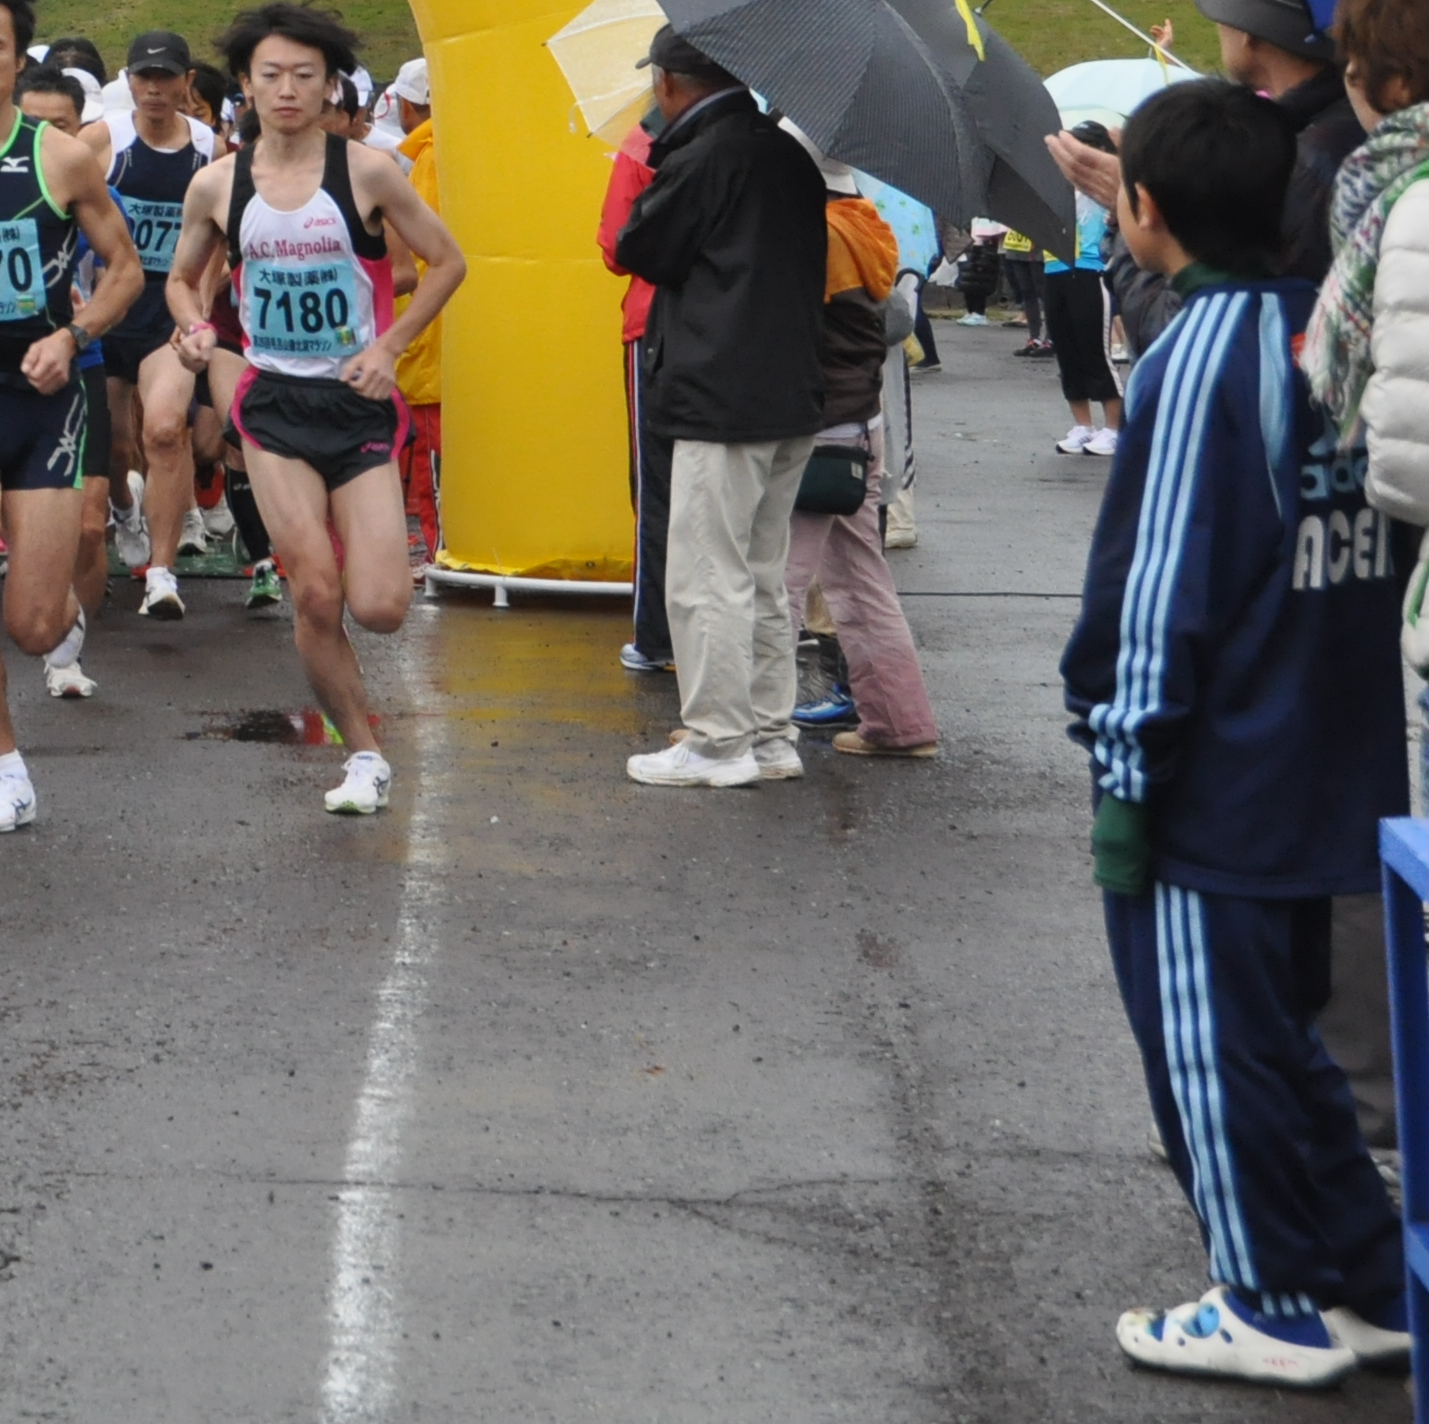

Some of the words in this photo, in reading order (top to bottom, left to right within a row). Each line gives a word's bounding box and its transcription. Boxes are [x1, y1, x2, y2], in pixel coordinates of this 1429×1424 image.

[127, 218, 183, 253] 077
[275, 235, 342, 261] Magnolia
[253, 286, 349, 334] 7180
